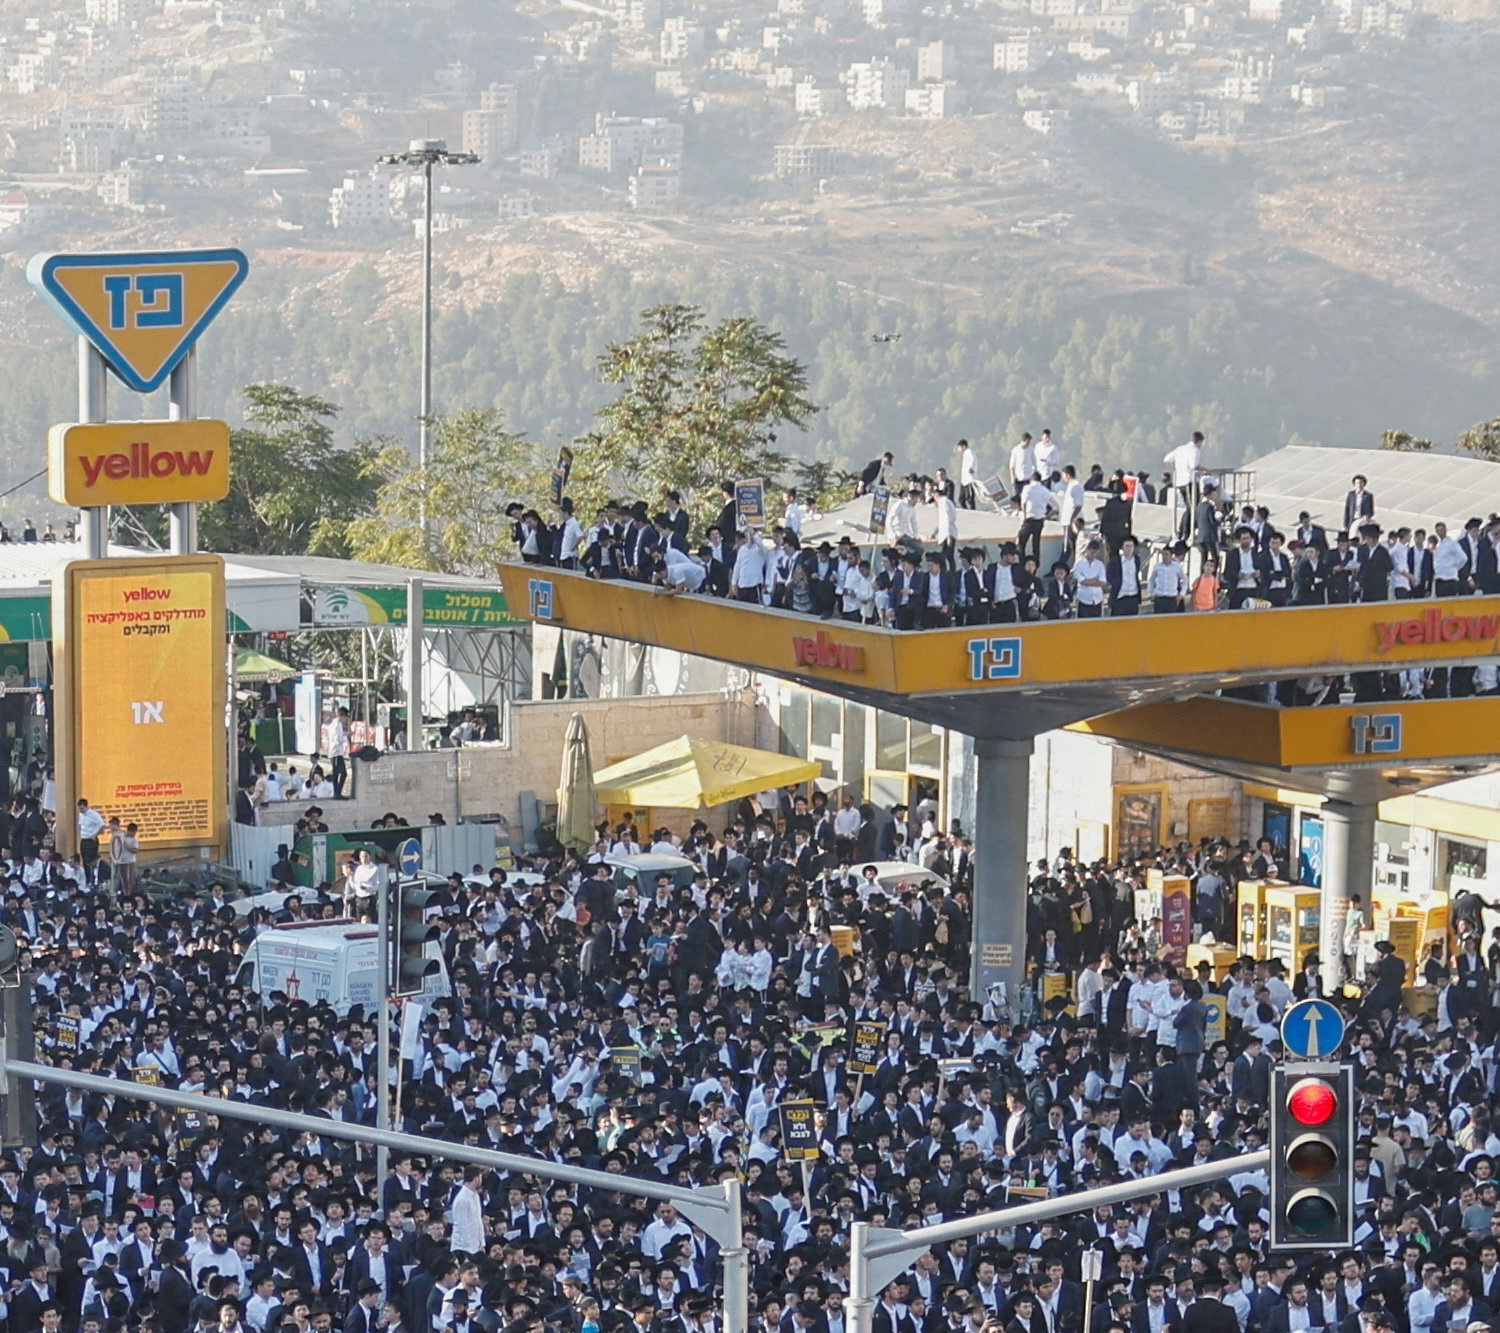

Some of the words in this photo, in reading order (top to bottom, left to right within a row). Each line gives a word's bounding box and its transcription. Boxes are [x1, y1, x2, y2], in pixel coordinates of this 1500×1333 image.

[103, 272, 184, 329] פז
[78, 442, 214, 487] yellow
[123, 587, 171, 603] yellow
[445, 593, 492, 607] מסלול
[87, 611, 150, 624] באפליקציה
[153, 608, 206, 622] מתדלקים
[123, 624, 171, 637] ומקבלים
[792, 631, 864, 671] yellow
[968, 636, 1022, 681] פז
[131, 701, 164, 725] או
[1350, 713, 1402, 754] פז
